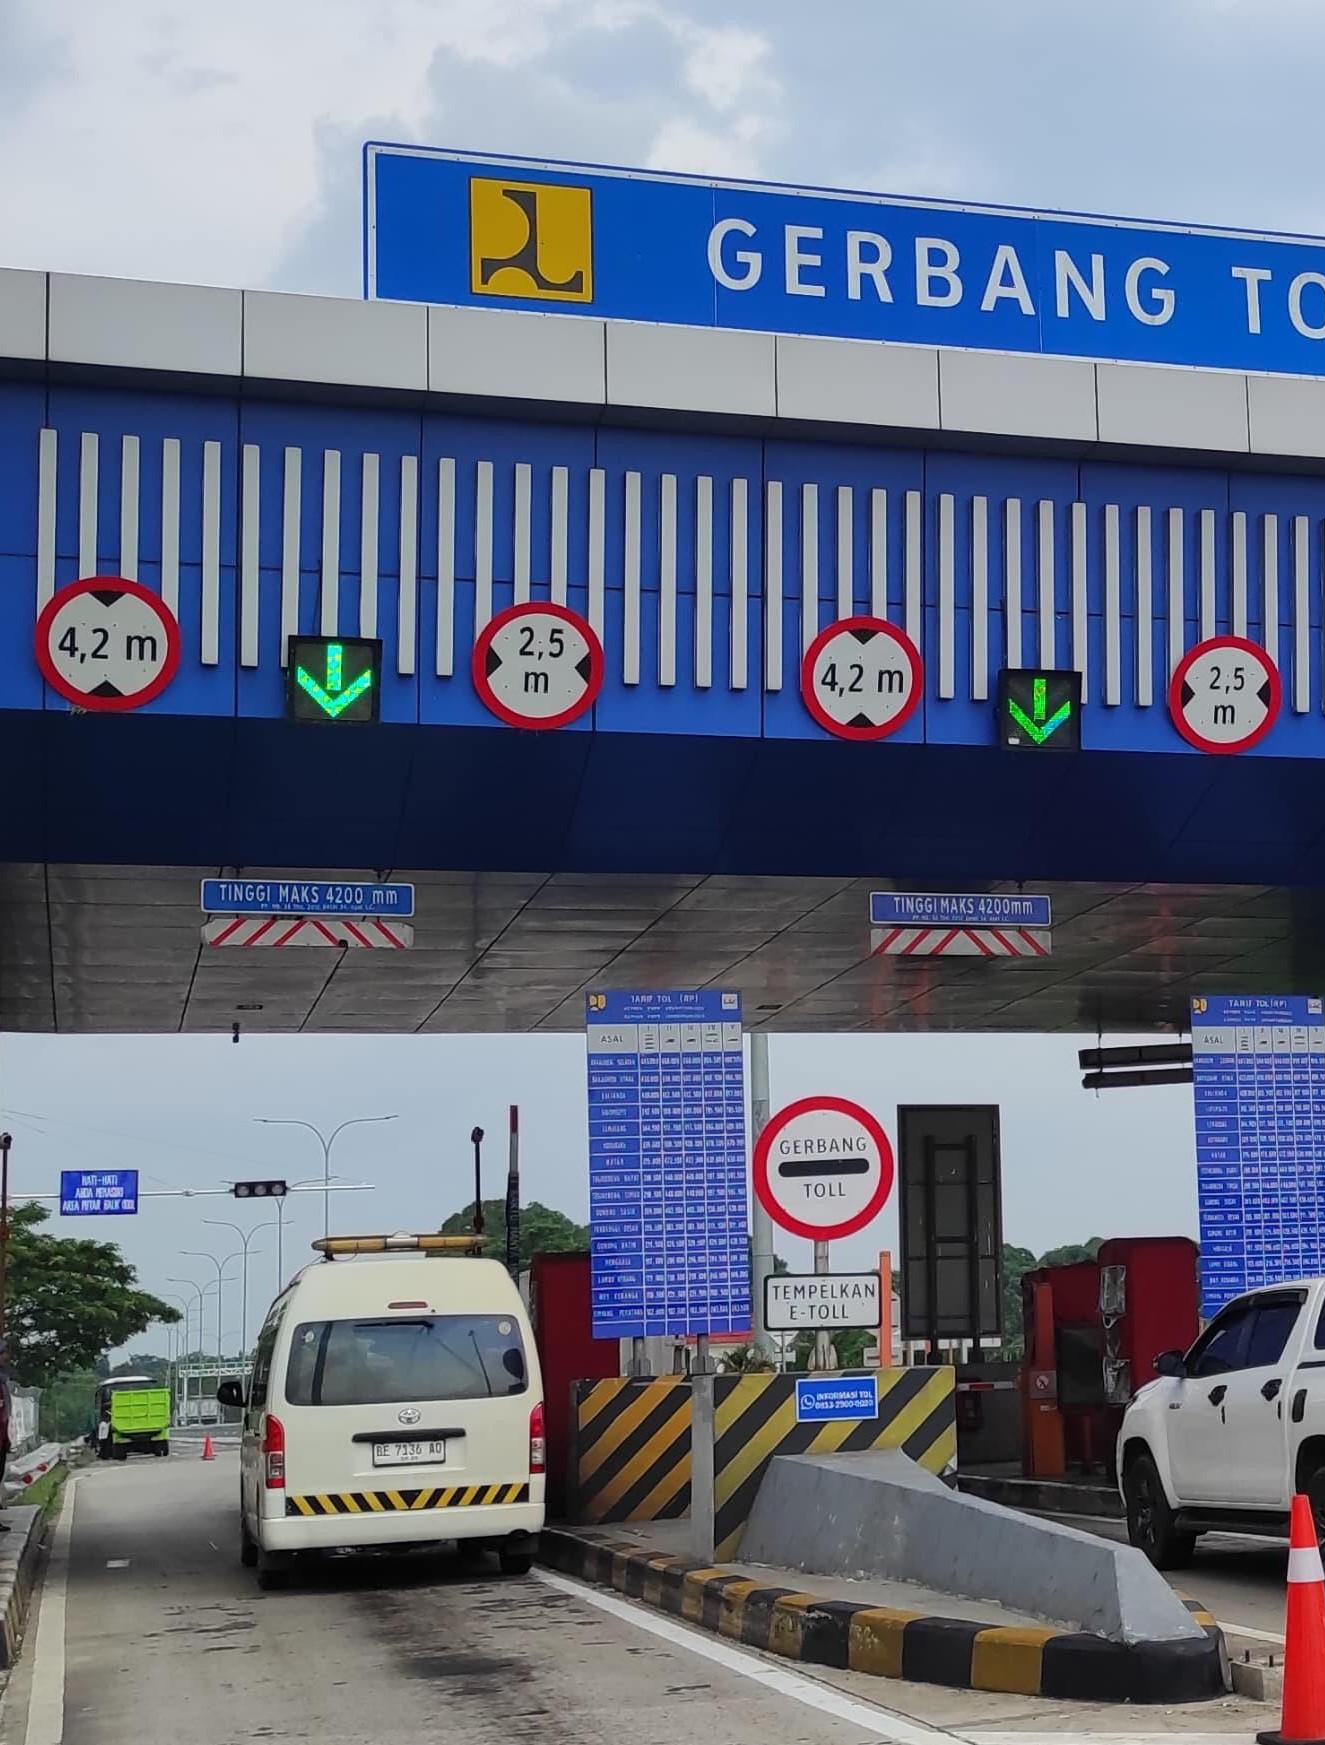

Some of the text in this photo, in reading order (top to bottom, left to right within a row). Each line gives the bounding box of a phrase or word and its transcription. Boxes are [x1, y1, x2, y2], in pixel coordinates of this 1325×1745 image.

[707, 217, 1177, 328] GERBANG
[58, 626, 157, 664] 4,2 m
[519, 626, 565, 660] 2,5
[524, 669, 548, 694] m
[821, 664, 904, 697] 4,2 m
[1209, 667, 1245, 694] 2,5
[1214, 703, 1236, 725] m
[219, 884, 398, 905] TINGGI MAKS 4200 mm
[894, 897, 937, 913] TINGGI
[941, 897, 974, 914] MAKS
[1204, 1036, 1223, 1044] ASAL
[780, 1137, 867, 1155] GERBANG
[803, 1182, 846, 1198] TOLL
[772, 1283, 875, 1300] TEMPELKAN
[790, 1304, 849, 1320] E-TOLL
[376, 1445, 391, 1456] BE
